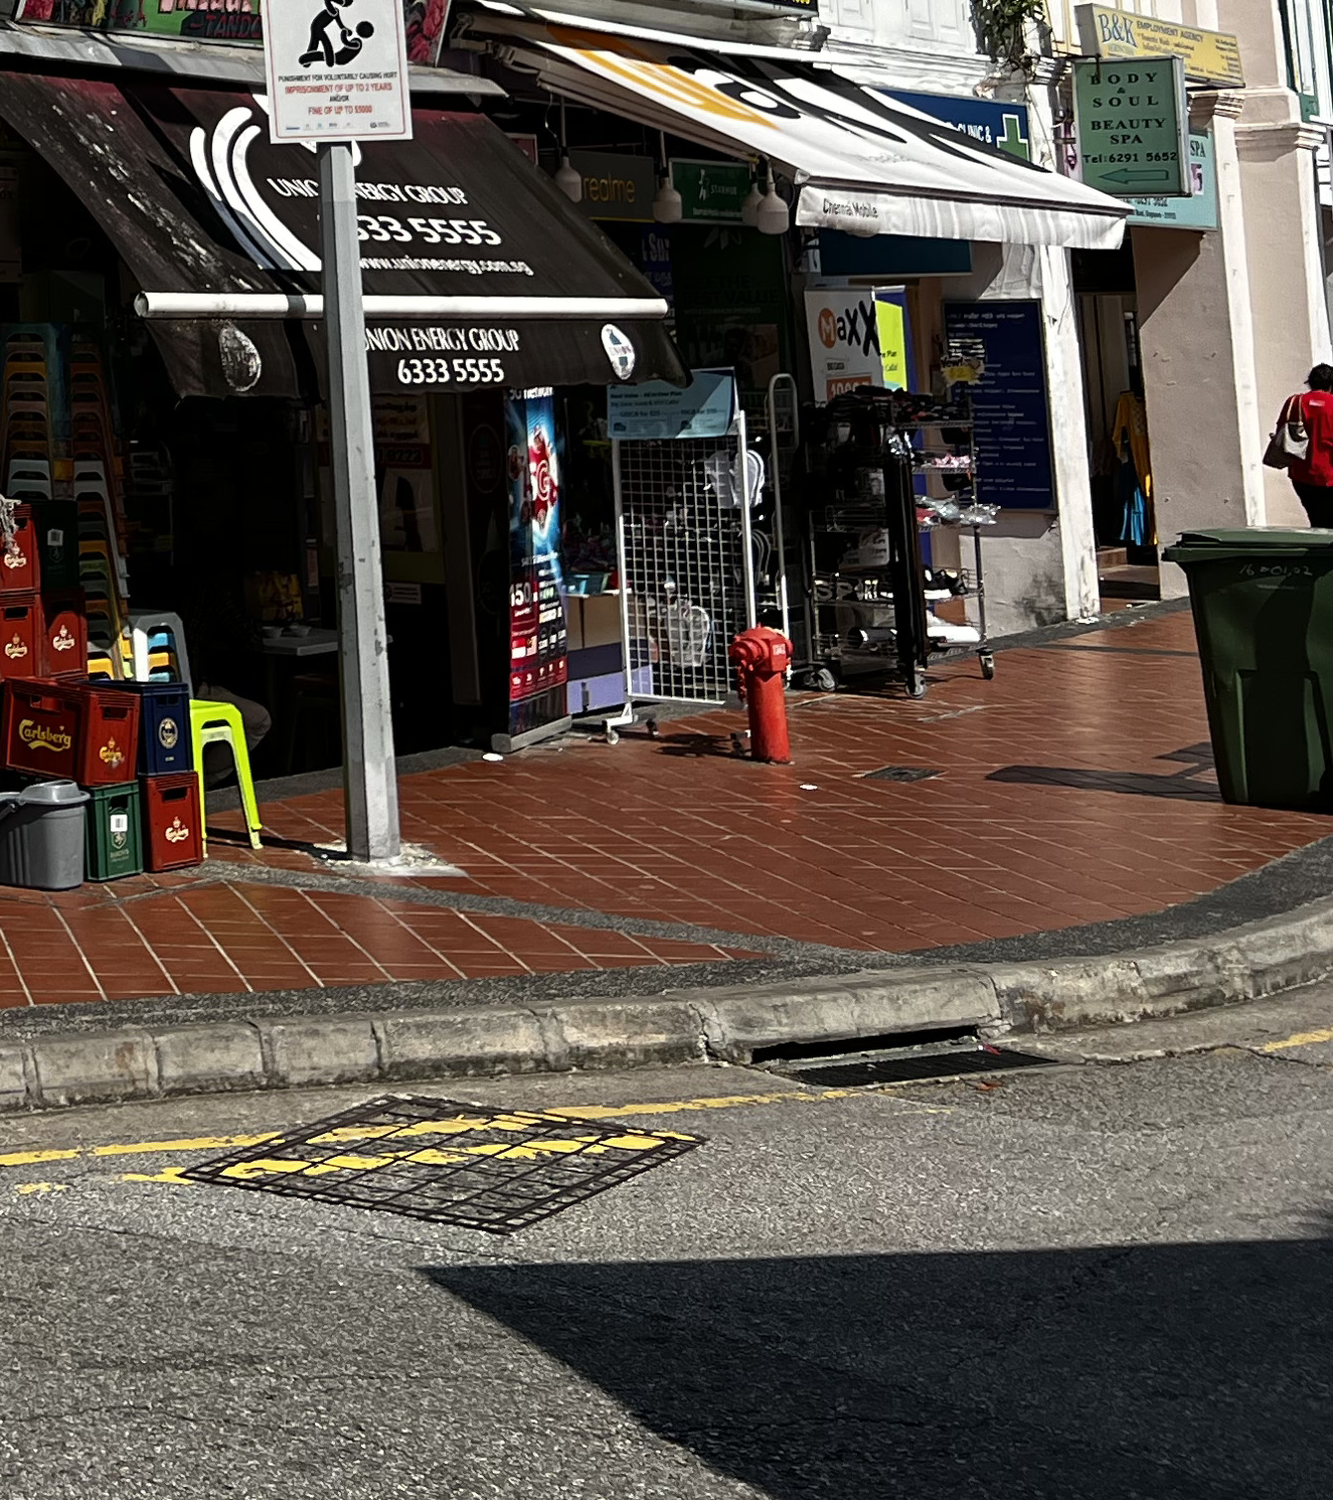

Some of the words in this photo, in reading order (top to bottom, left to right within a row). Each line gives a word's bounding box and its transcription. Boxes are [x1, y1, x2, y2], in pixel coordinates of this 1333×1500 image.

[1098, 13, 1138, 49] B&K
[345, 84, 354, 92] UP
[356, 83, 364, 92] TO
[1093, 95, 1159, 108] SOUL
[1091, 118, 1166, 131] BEAUTY
[1110, 134, 1142, 145] SPA
[1190, 140, 1206, 158] SPA
[1146, 151, 1178, 161] 5652
[408, 184, 469, 205] GROUP
[584, 172, 635, 203] realme
[407, 218, 502, 245] 5555
[414, 328, 468, 351] ENERGY
[468, 328, 519, 351] GROUP
[398, 359, 450, 383] 6333
[453, 359, 504, 383] 5555
[18, 719, 72, 751] Carlsberg
